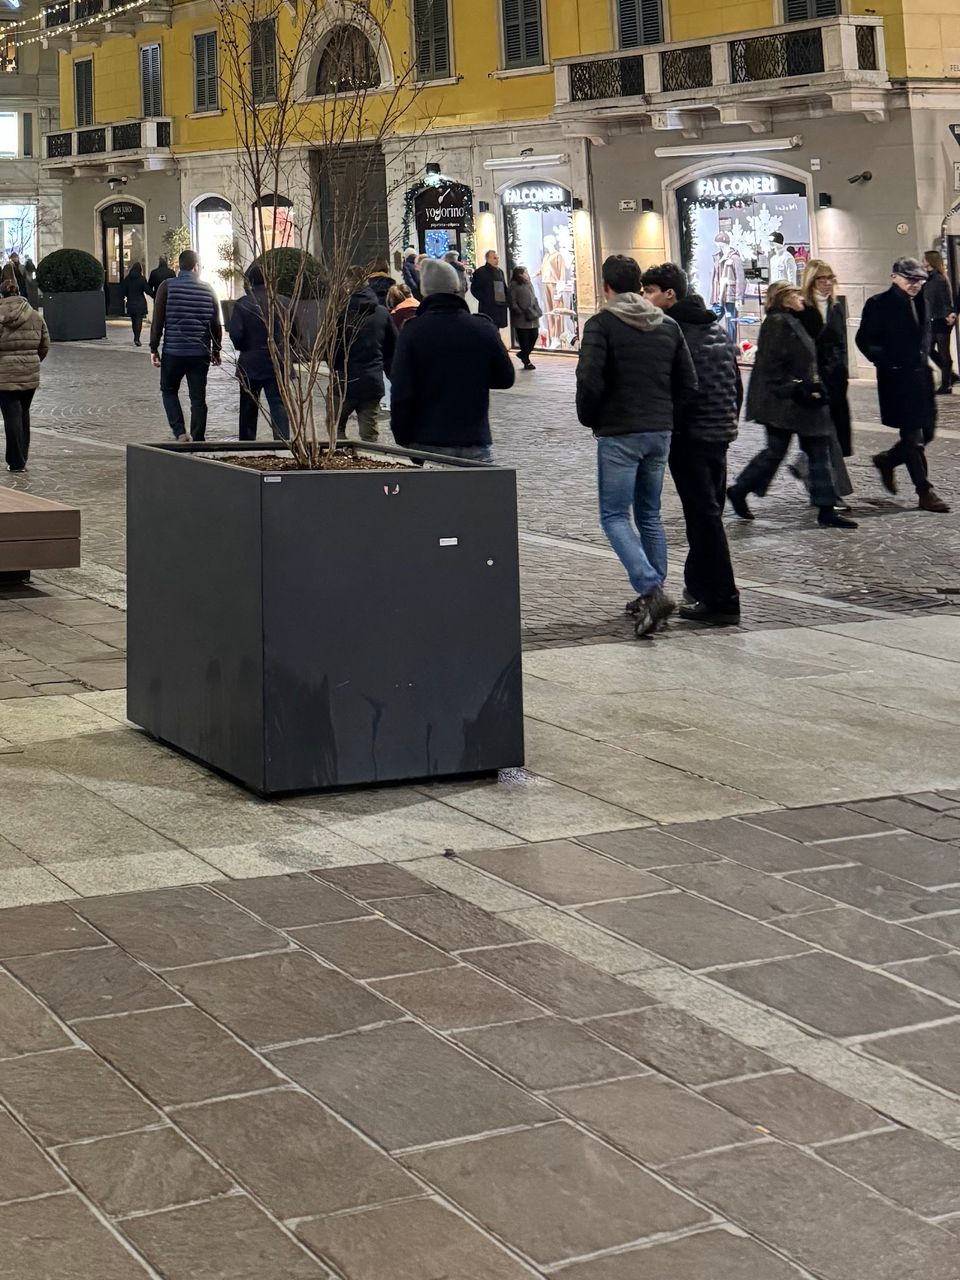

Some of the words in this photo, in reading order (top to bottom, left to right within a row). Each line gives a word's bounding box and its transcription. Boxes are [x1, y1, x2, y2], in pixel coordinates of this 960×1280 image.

[504, 186, 564, 203] FALCONERI
[698, 176, 777, 196] FALCONERI
[426, 204, 464, 221] yogorino
